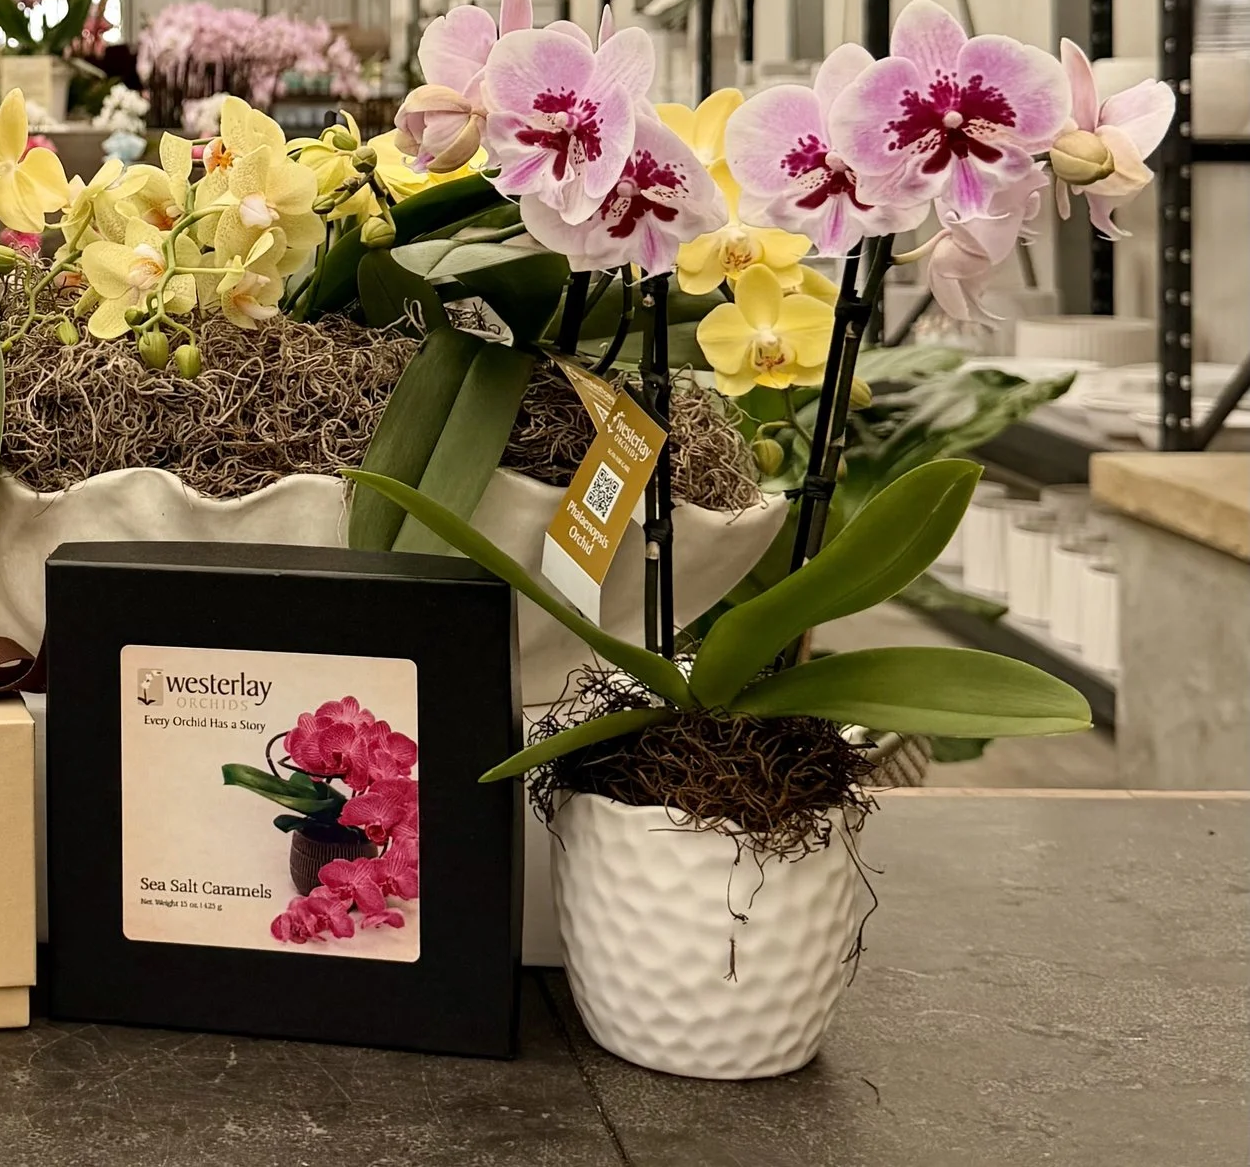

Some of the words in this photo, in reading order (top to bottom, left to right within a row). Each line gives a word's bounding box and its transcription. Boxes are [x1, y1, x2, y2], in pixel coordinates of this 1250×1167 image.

[616, 418, 653, 462] westerlay
[566, 500, 610, 549] Phalaenopsis
[568, 525, 593, 556] Orchid
[166, 672, 272, 706] westerlay
[176, 697, 248, 711] ORCHIDS
[144, 715, 170, 729] Every
[173, 716, 207, 728] Orchid
[210, 718, 228, 728] Has
[240, 720, 266, 734] Story
[140, 877, 166, 891] Sea
[170, 879, 198, 893] Salt
[202, 881, 272, 899] Caramels
